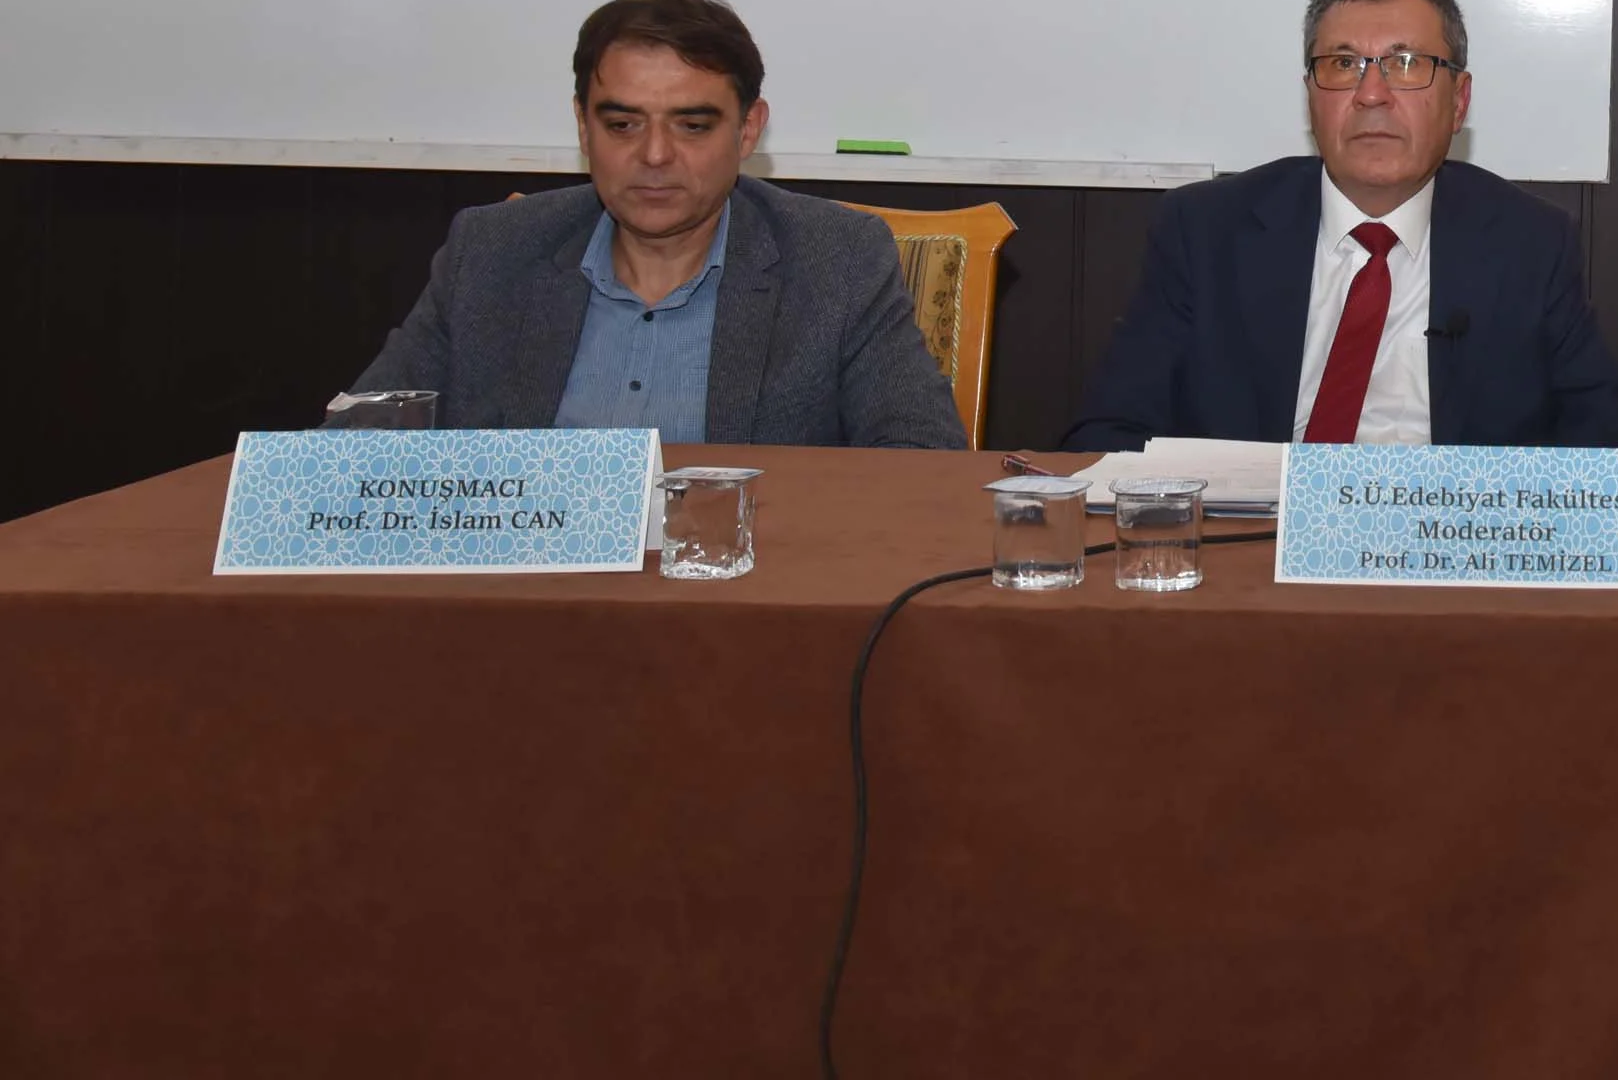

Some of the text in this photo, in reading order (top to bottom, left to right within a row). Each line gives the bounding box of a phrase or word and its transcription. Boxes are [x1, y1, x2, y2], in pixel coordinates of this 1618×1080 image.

[359, 479, 525, 503] KONUŞMACI
[308, 510, 566, 531] Prof. Dr. İslam CAN
[1417, 520, 1557, 542] Moderatör
[1360, 550, 1613, 573] Prof. Dr. Ali TEMİZEL
